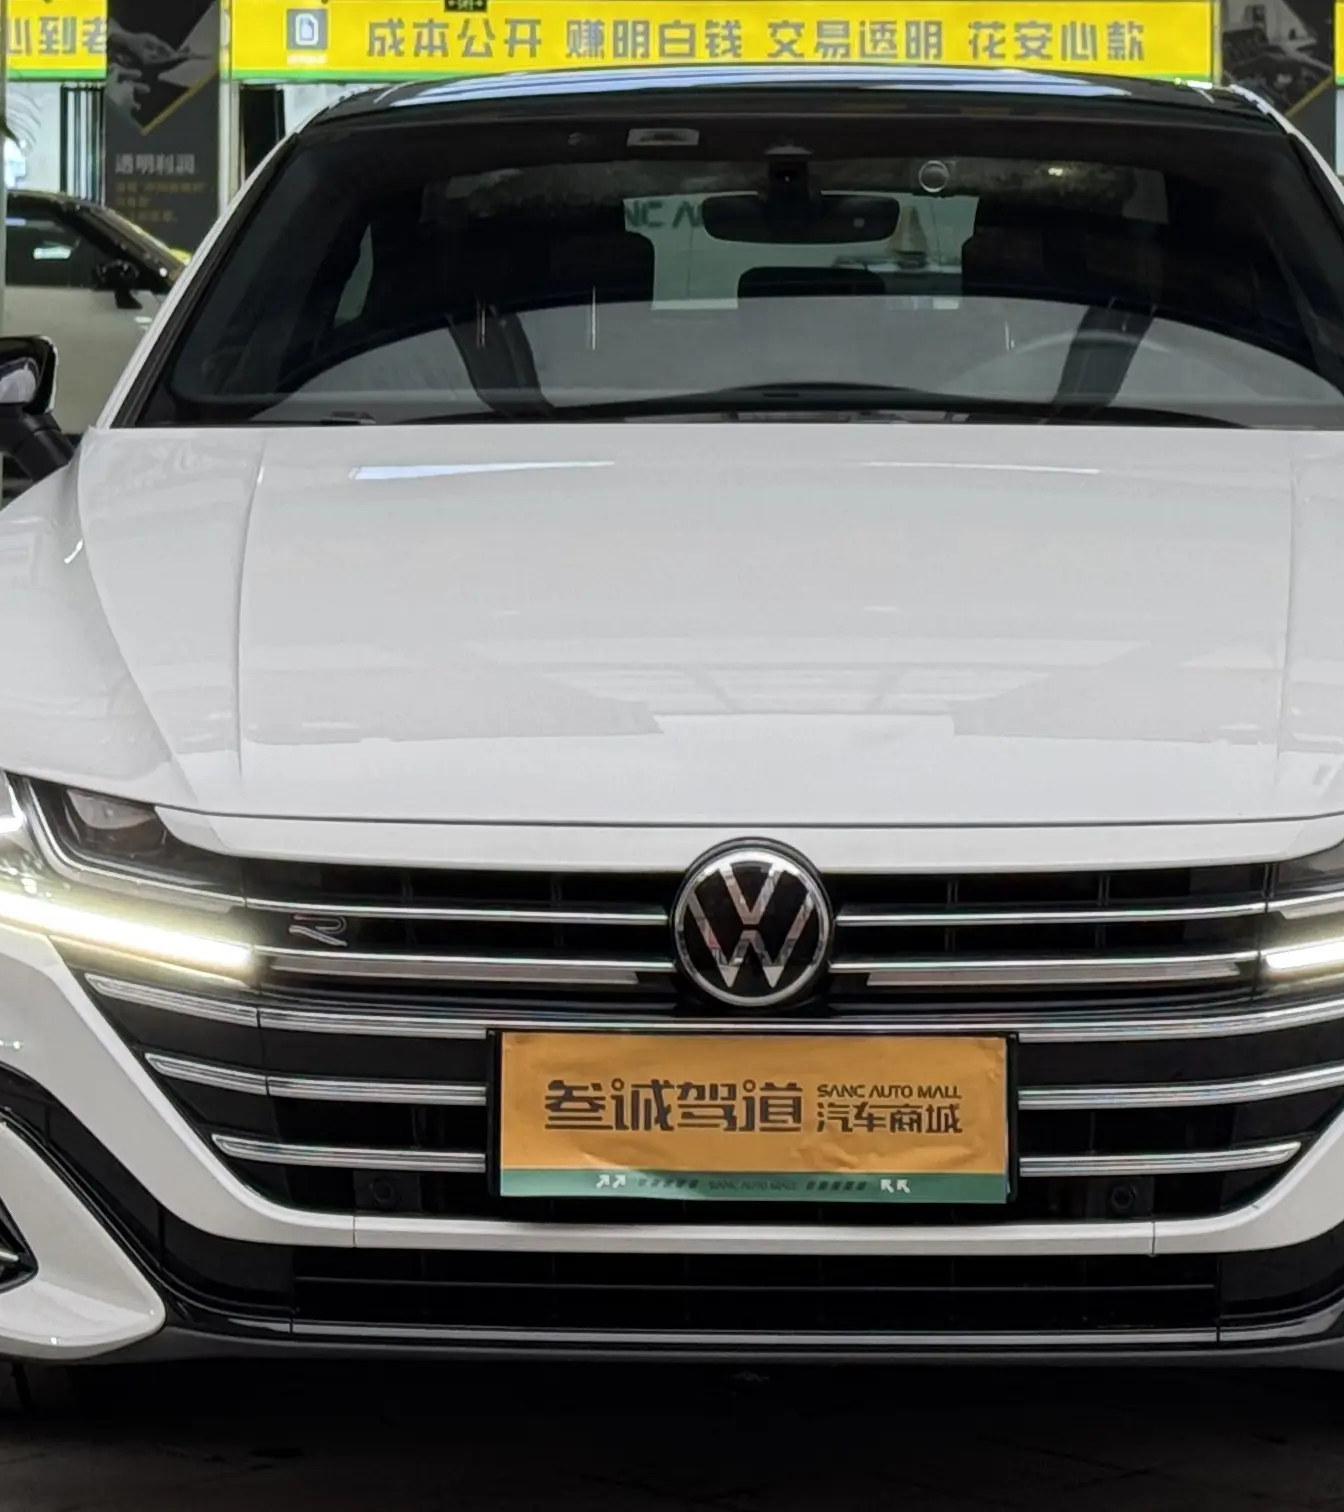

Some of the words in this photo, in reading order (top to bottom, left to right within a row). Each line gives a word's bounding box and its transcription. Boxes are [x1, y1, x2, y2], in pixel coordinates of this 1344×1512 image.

[367, 18, 542, 58] 成本公开
[565, 19, 743, 59] 赚明白钱
[767, 20, 943, 60] 交易透明
[969, 21, 1145, 62] 花安心款
[680, 856, 823, 996] VW
[545, 1078, 803, 1133] 叁诚驾道
[868, 1085, 913, 1099] AUTO
[917, 1085, 963, 1100] MALL
[816, 1101, 964, 1134] 汽车商城
